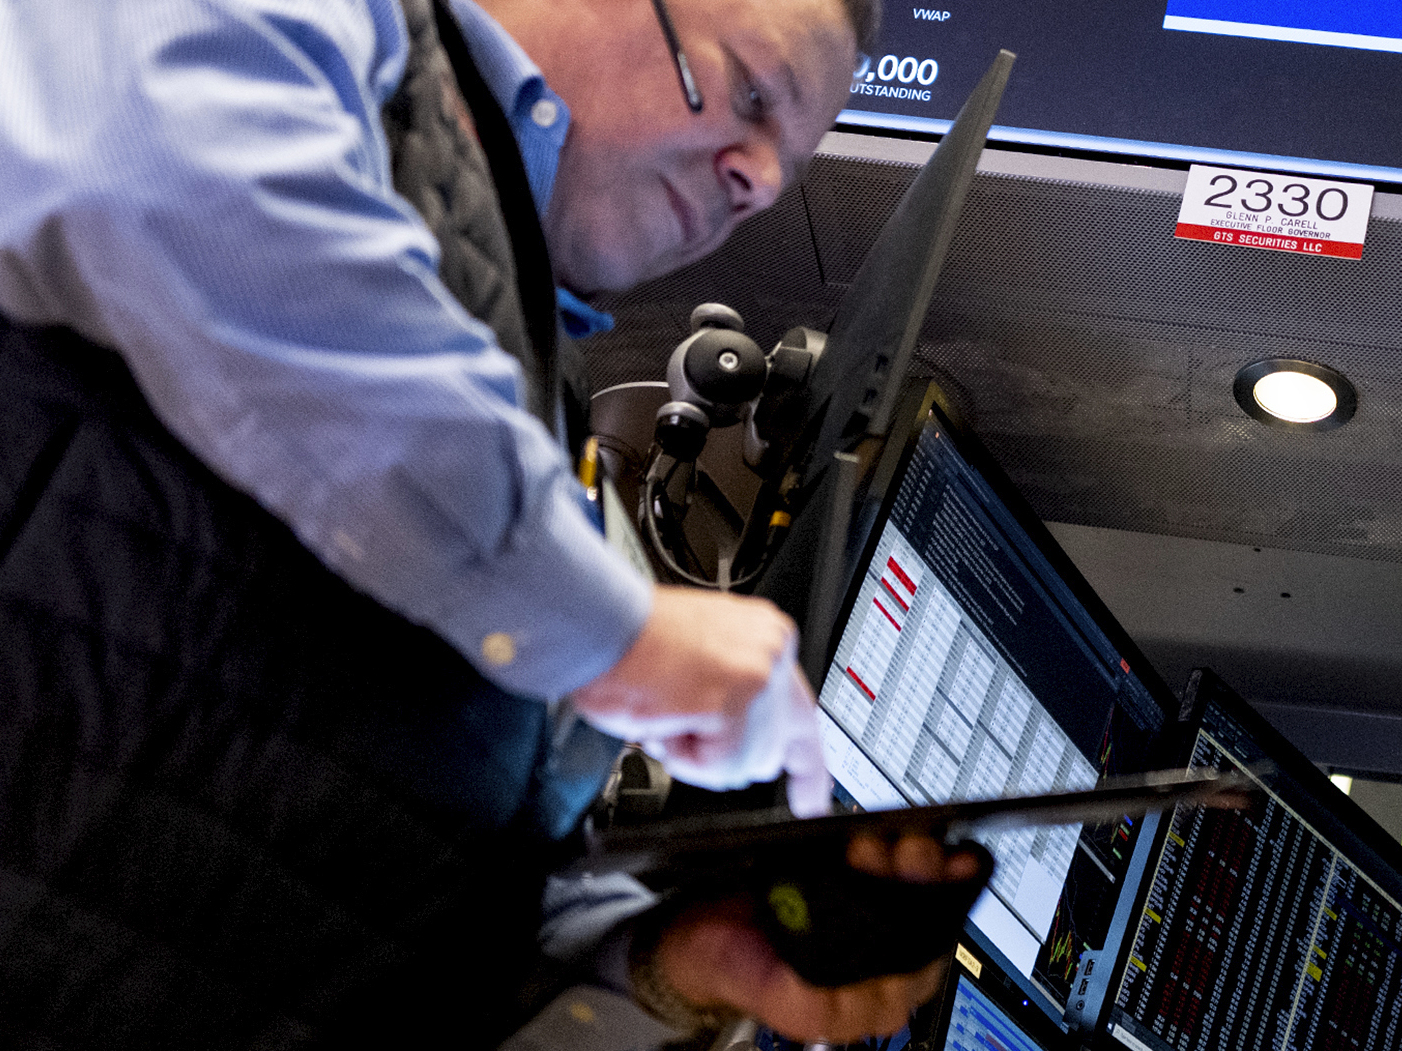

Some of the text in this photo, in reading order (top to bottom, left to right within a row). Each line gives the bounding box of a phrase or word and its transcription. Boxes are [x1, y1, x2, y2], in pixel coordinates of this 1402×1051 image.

[912, 8, 951, 22] VWAP
[849, 82, 932, 102] UTSTANDING
[1204, 175, 1348, 221] 2330
[1210, 218, 1331, 240] EXECUTIVE FLOOR GOVERNOR
[1225, 211, 1259, 223] GLENN
[1280, 218, 1318, 230] CARELL
[1213, 231, 1323, 253] GTS SECURITIES LLC
